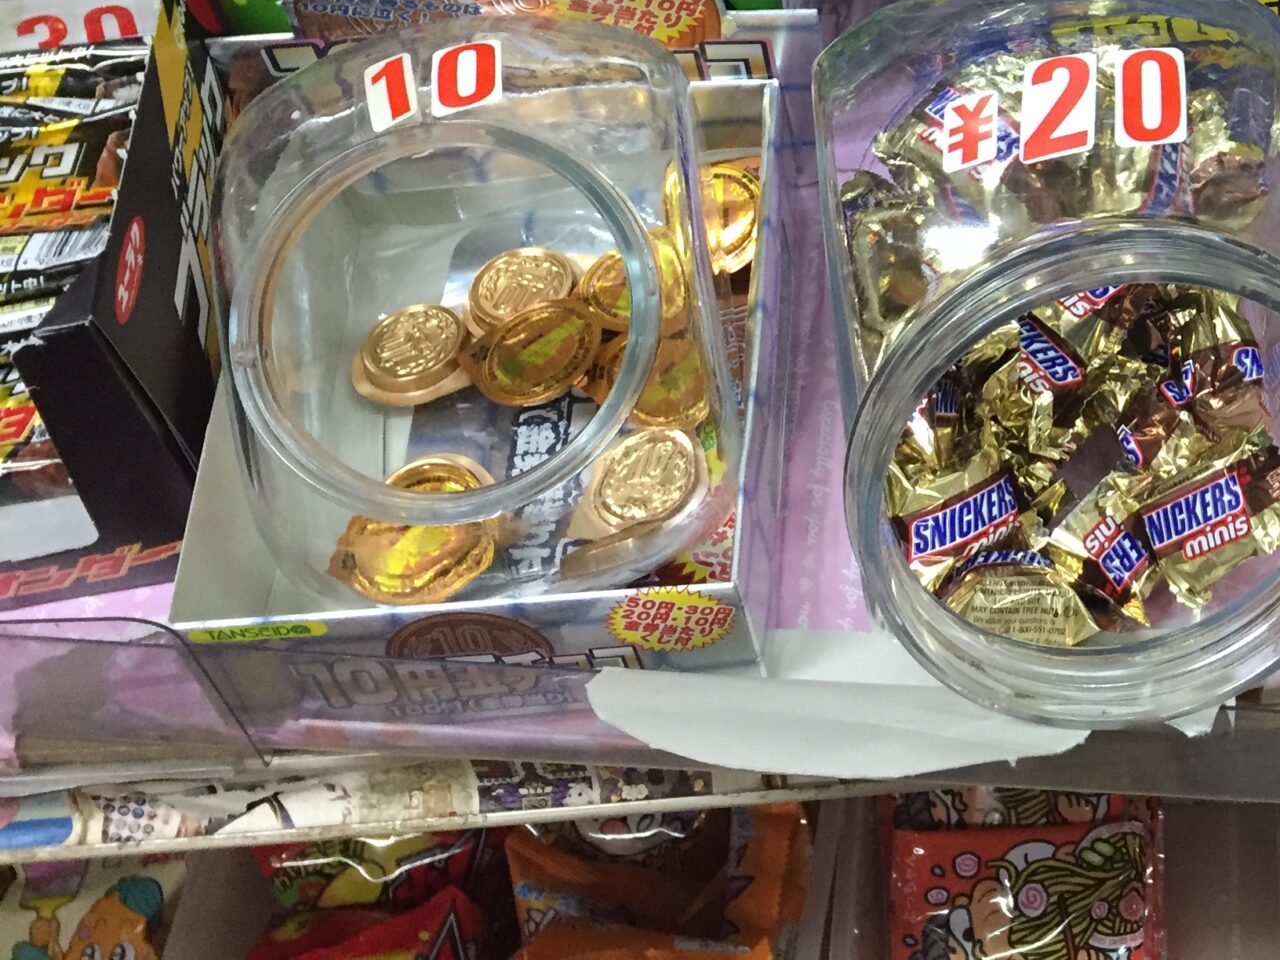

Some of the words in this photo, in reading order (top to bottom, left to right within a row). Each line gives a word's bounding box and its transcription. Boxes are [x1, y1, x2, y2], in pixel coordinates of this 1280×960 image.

[371, 43, 497, 121] 10
[947, 48, 1182, 165] ¥20
[913, 478, 1018, 556] SNICKERS
[1185, 516, 1249, 558] minis
[621, 608, 728, 629] 20円・10円
[626, 596, 734, 618] 50円・30円
[989, 607, 1020, 615] CONTAIN
[1022, 606, 1038, 614] TREE
